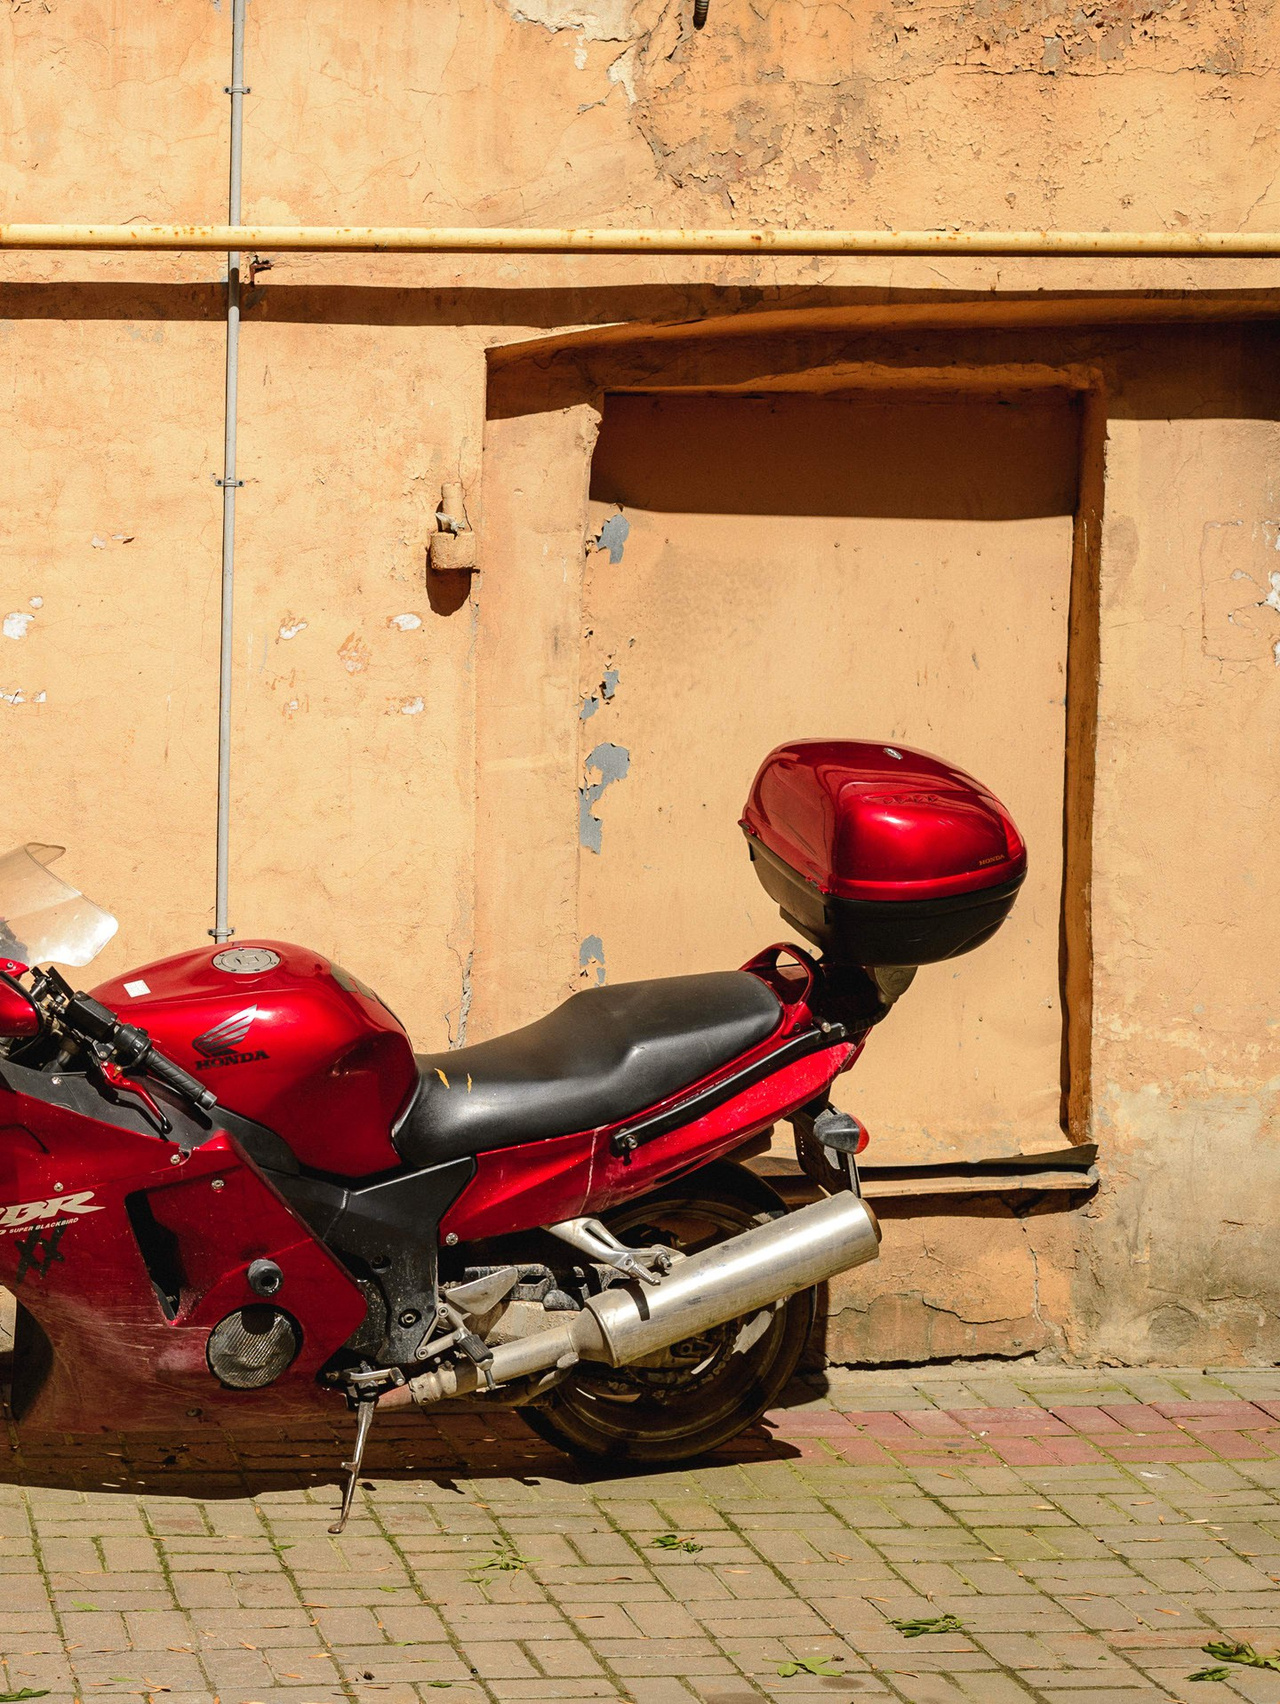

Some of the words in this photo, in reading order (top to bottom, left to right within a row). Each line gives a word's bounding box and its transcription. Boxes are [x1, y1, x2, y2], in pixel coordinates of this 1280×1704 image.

[978, 854, 1006, 866] HONDA
[195, 1050, 271, 1071] HONDA
[8, 1225, 35, 1234] SUPER
[34, 1217, 80, 1231] BLACKBIRD
